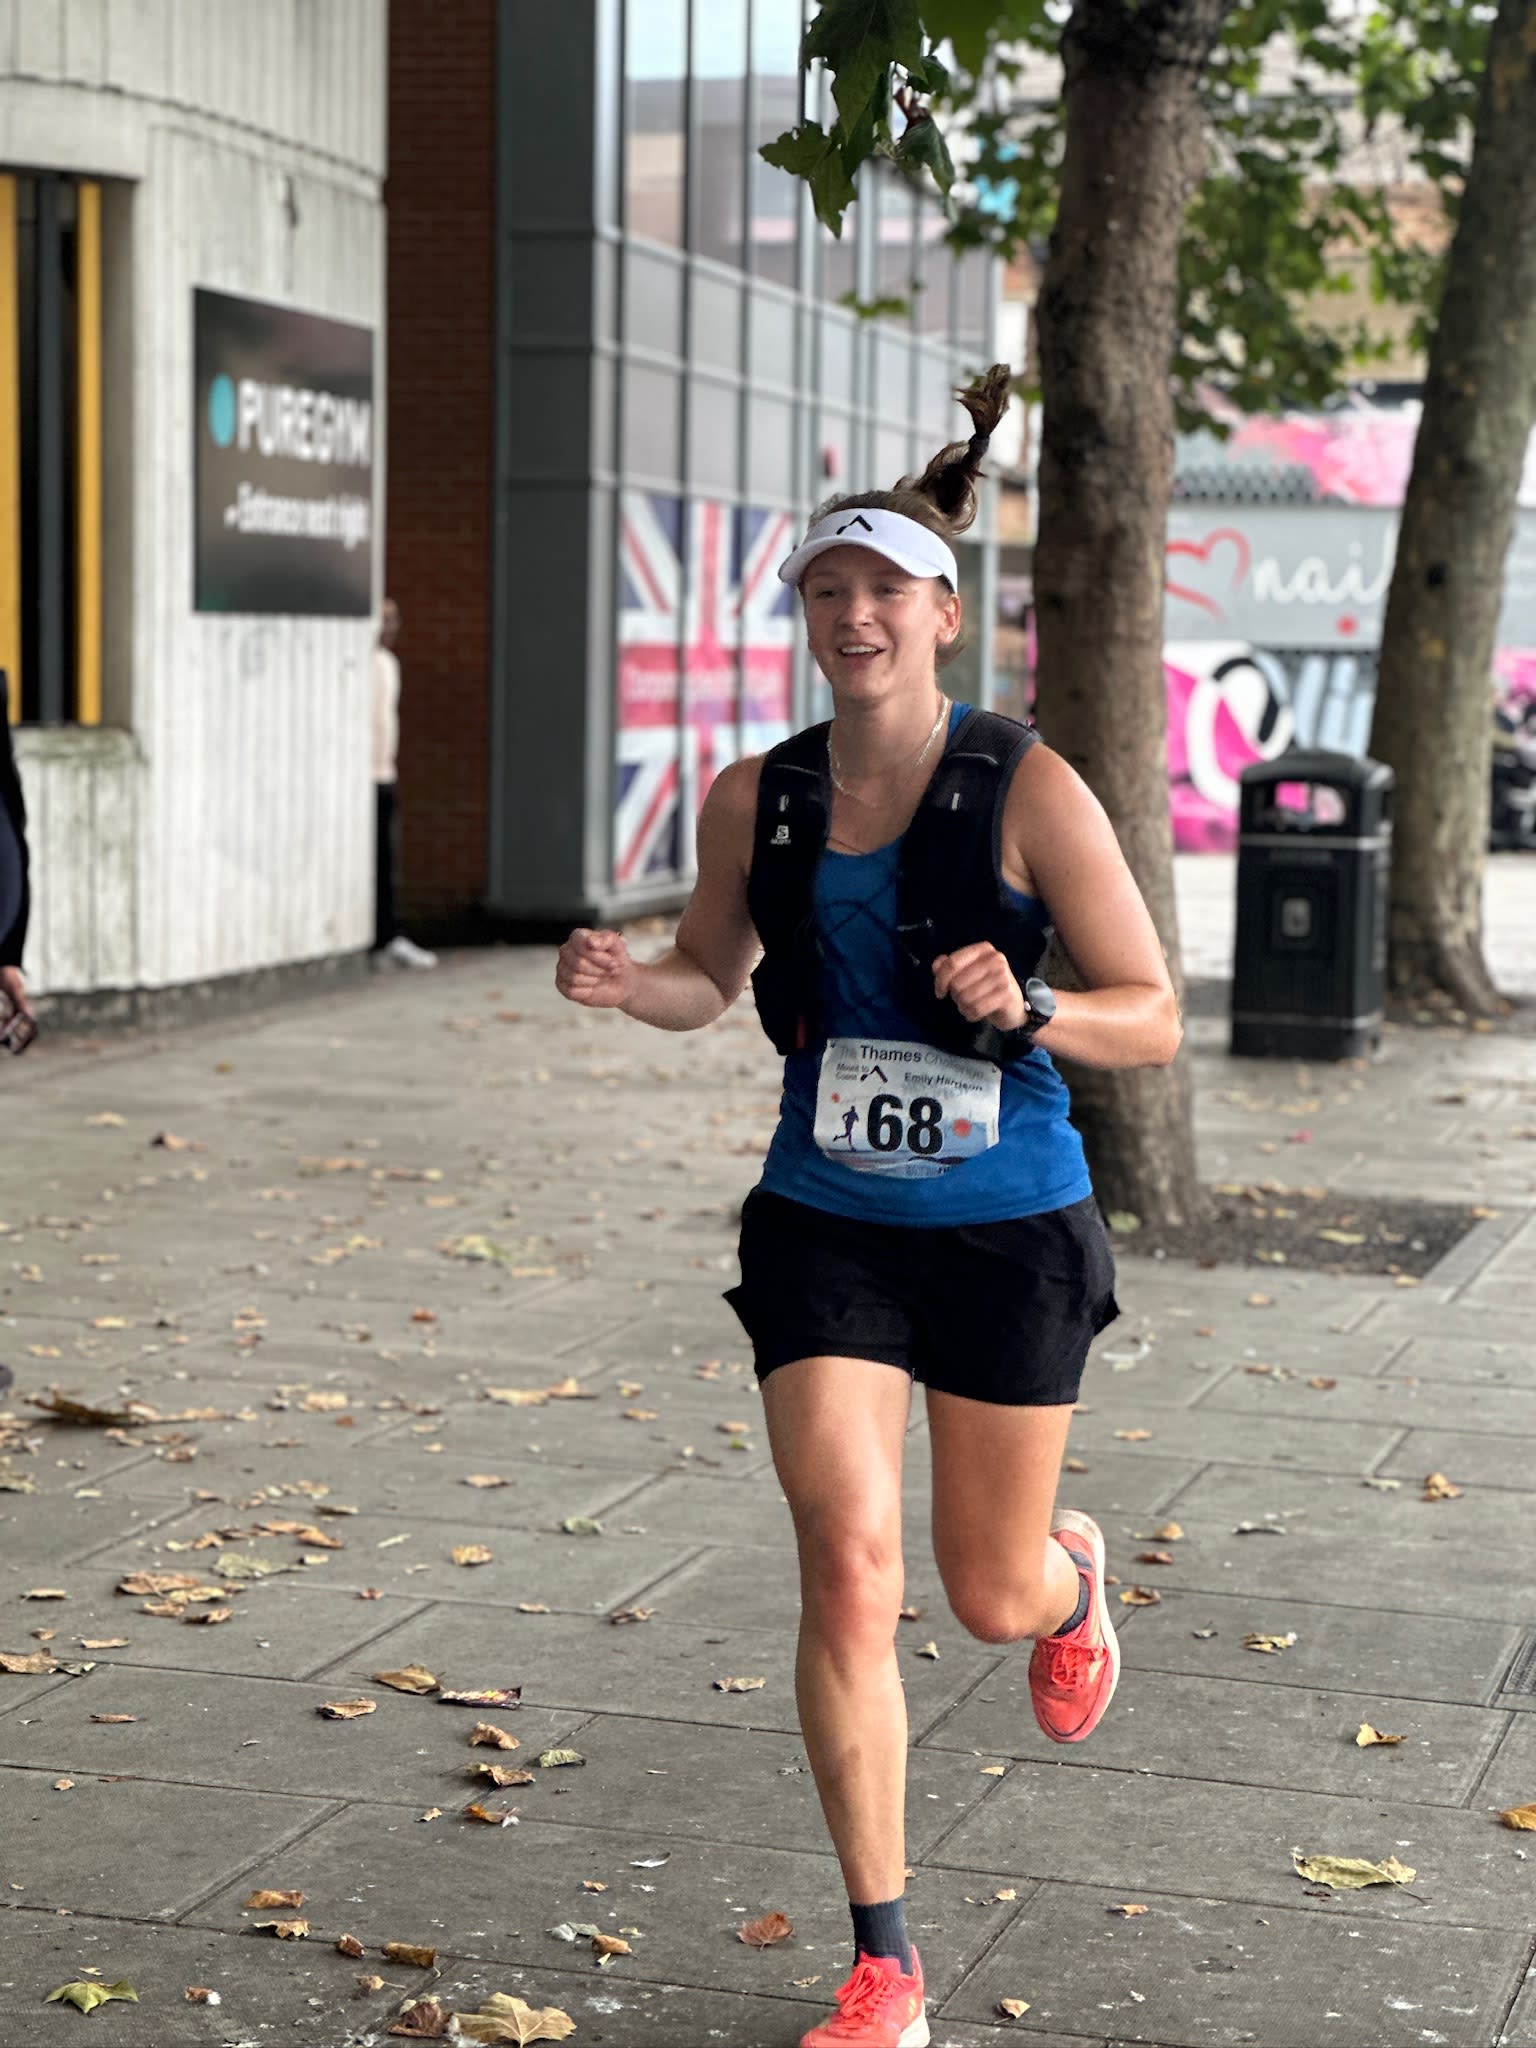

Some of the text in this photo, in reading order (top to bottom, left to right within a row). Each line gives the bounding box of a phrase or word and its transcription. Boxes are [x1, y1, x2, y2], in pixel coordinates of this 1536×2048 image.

[237, 378, 371, 468] PUREGYM
[860, 1044, 922, 1062] Thames
[904, 1072, 933, 1086] Emily
[867, 1094, 944, 1155] 68
